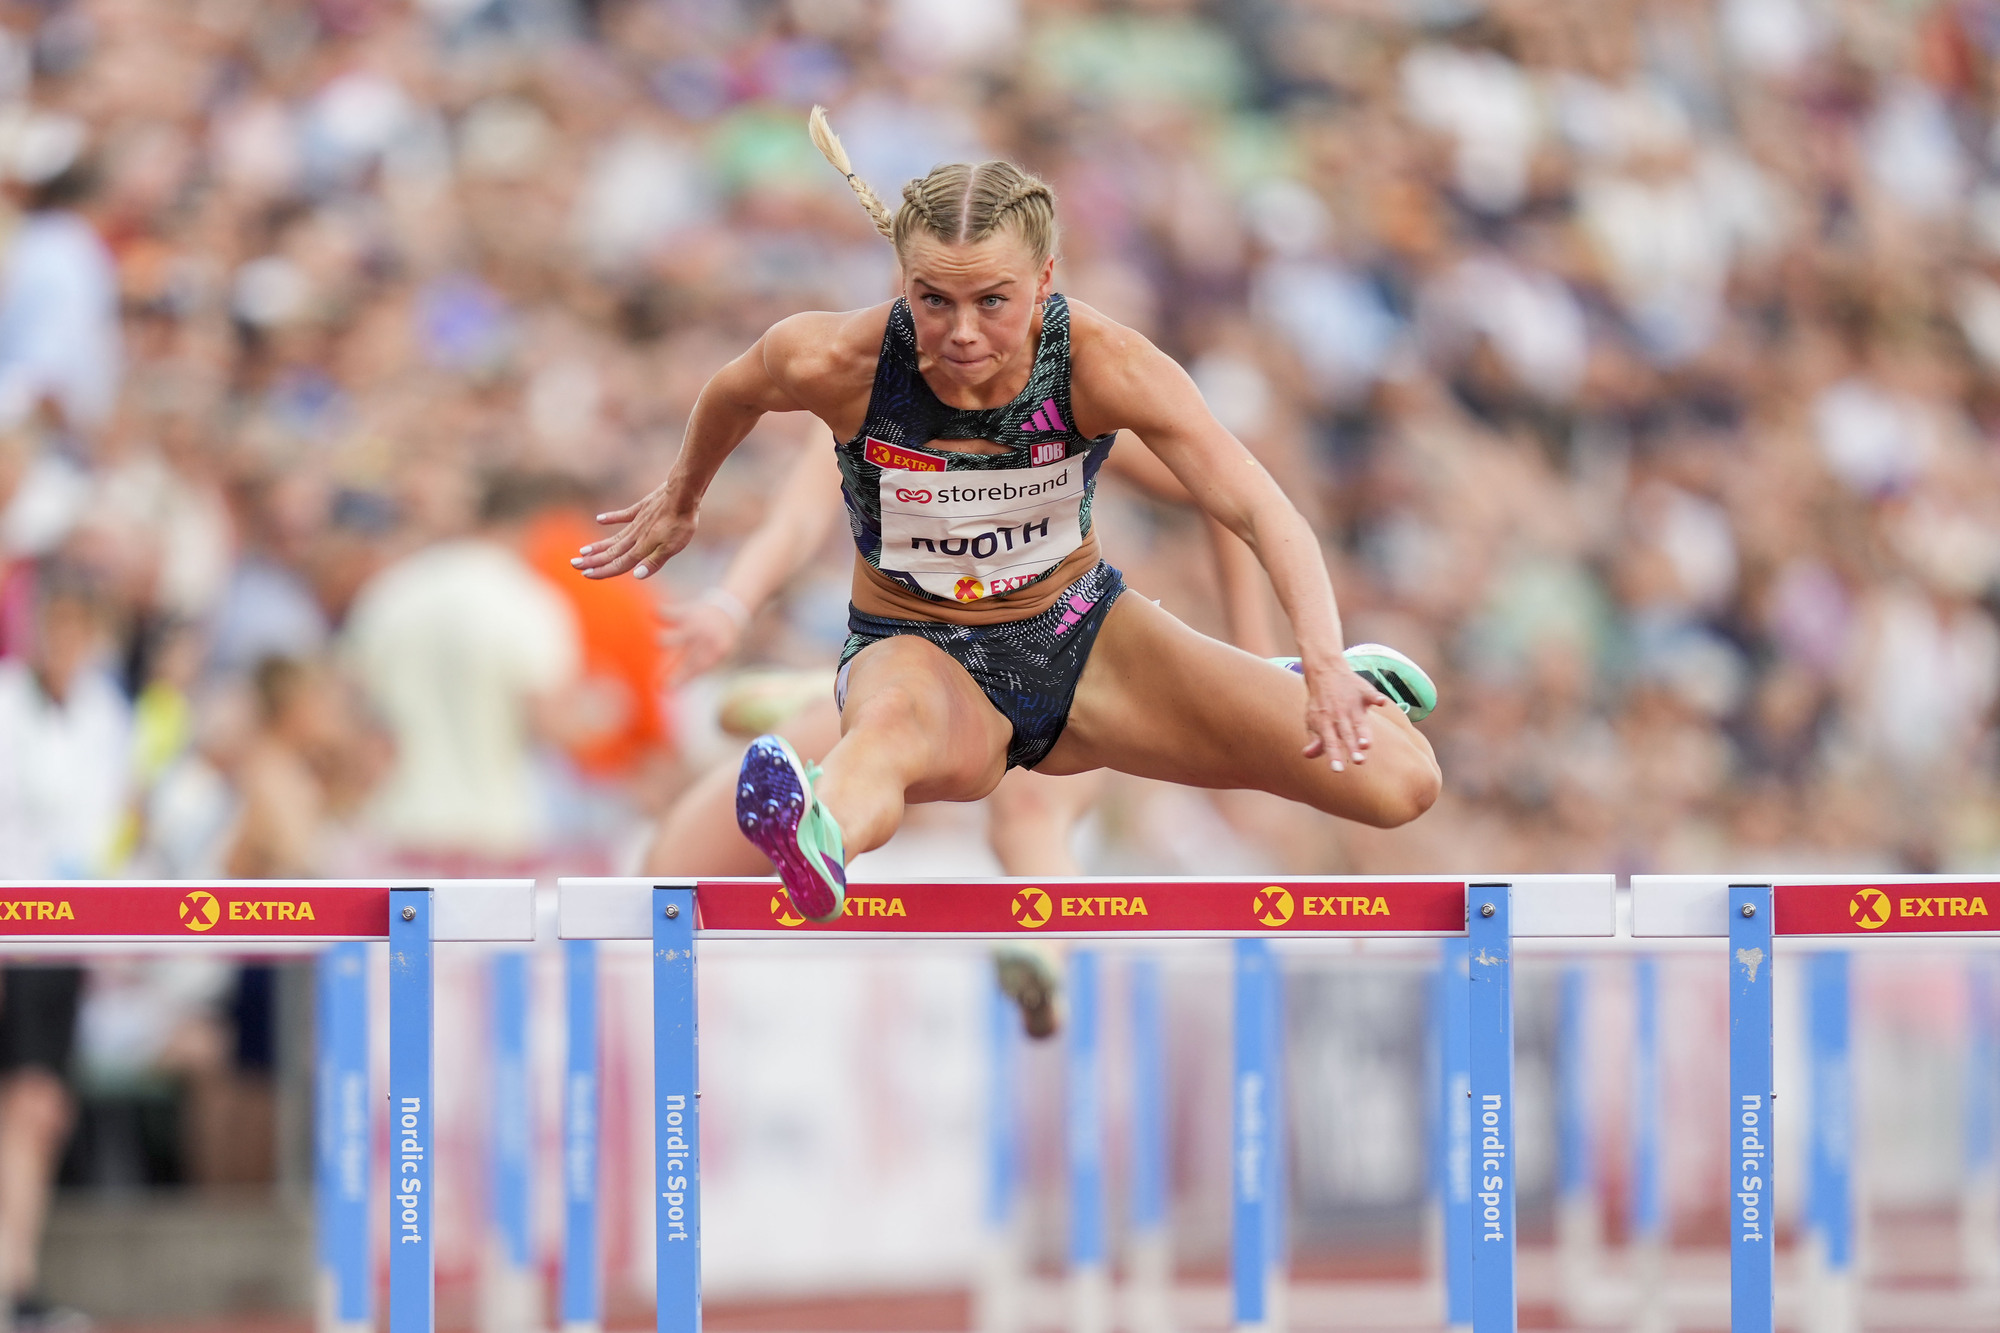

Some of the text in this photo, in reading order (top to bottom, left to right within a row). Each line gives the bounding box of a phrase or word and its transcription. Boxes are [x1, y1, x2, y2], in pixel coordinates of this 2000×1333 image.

[893, 454, 937, 472] EXTRA
[1033, 443, 1063, 465] JOB
[937, 468, 1069, 504] storebrand
[0, 901, 75, 920] XTRA
[229, 901, 316, 921] EXTRA
[842, 897, 907, 917] XTRA
[1061, 896, 1148, 917] EXTRA
[1303, 896, 1390, 916] EXTRA
[1900, 897, 1988, 917] EXTRA
[396, 1097, 424, 1244] nordic Sport
[662, 1094, 689, 1242] nordic Sport
[1478, 1094, 1505, 1242] nordic Sport
[1737, 1094, 1764, 1243] nordic Sport
